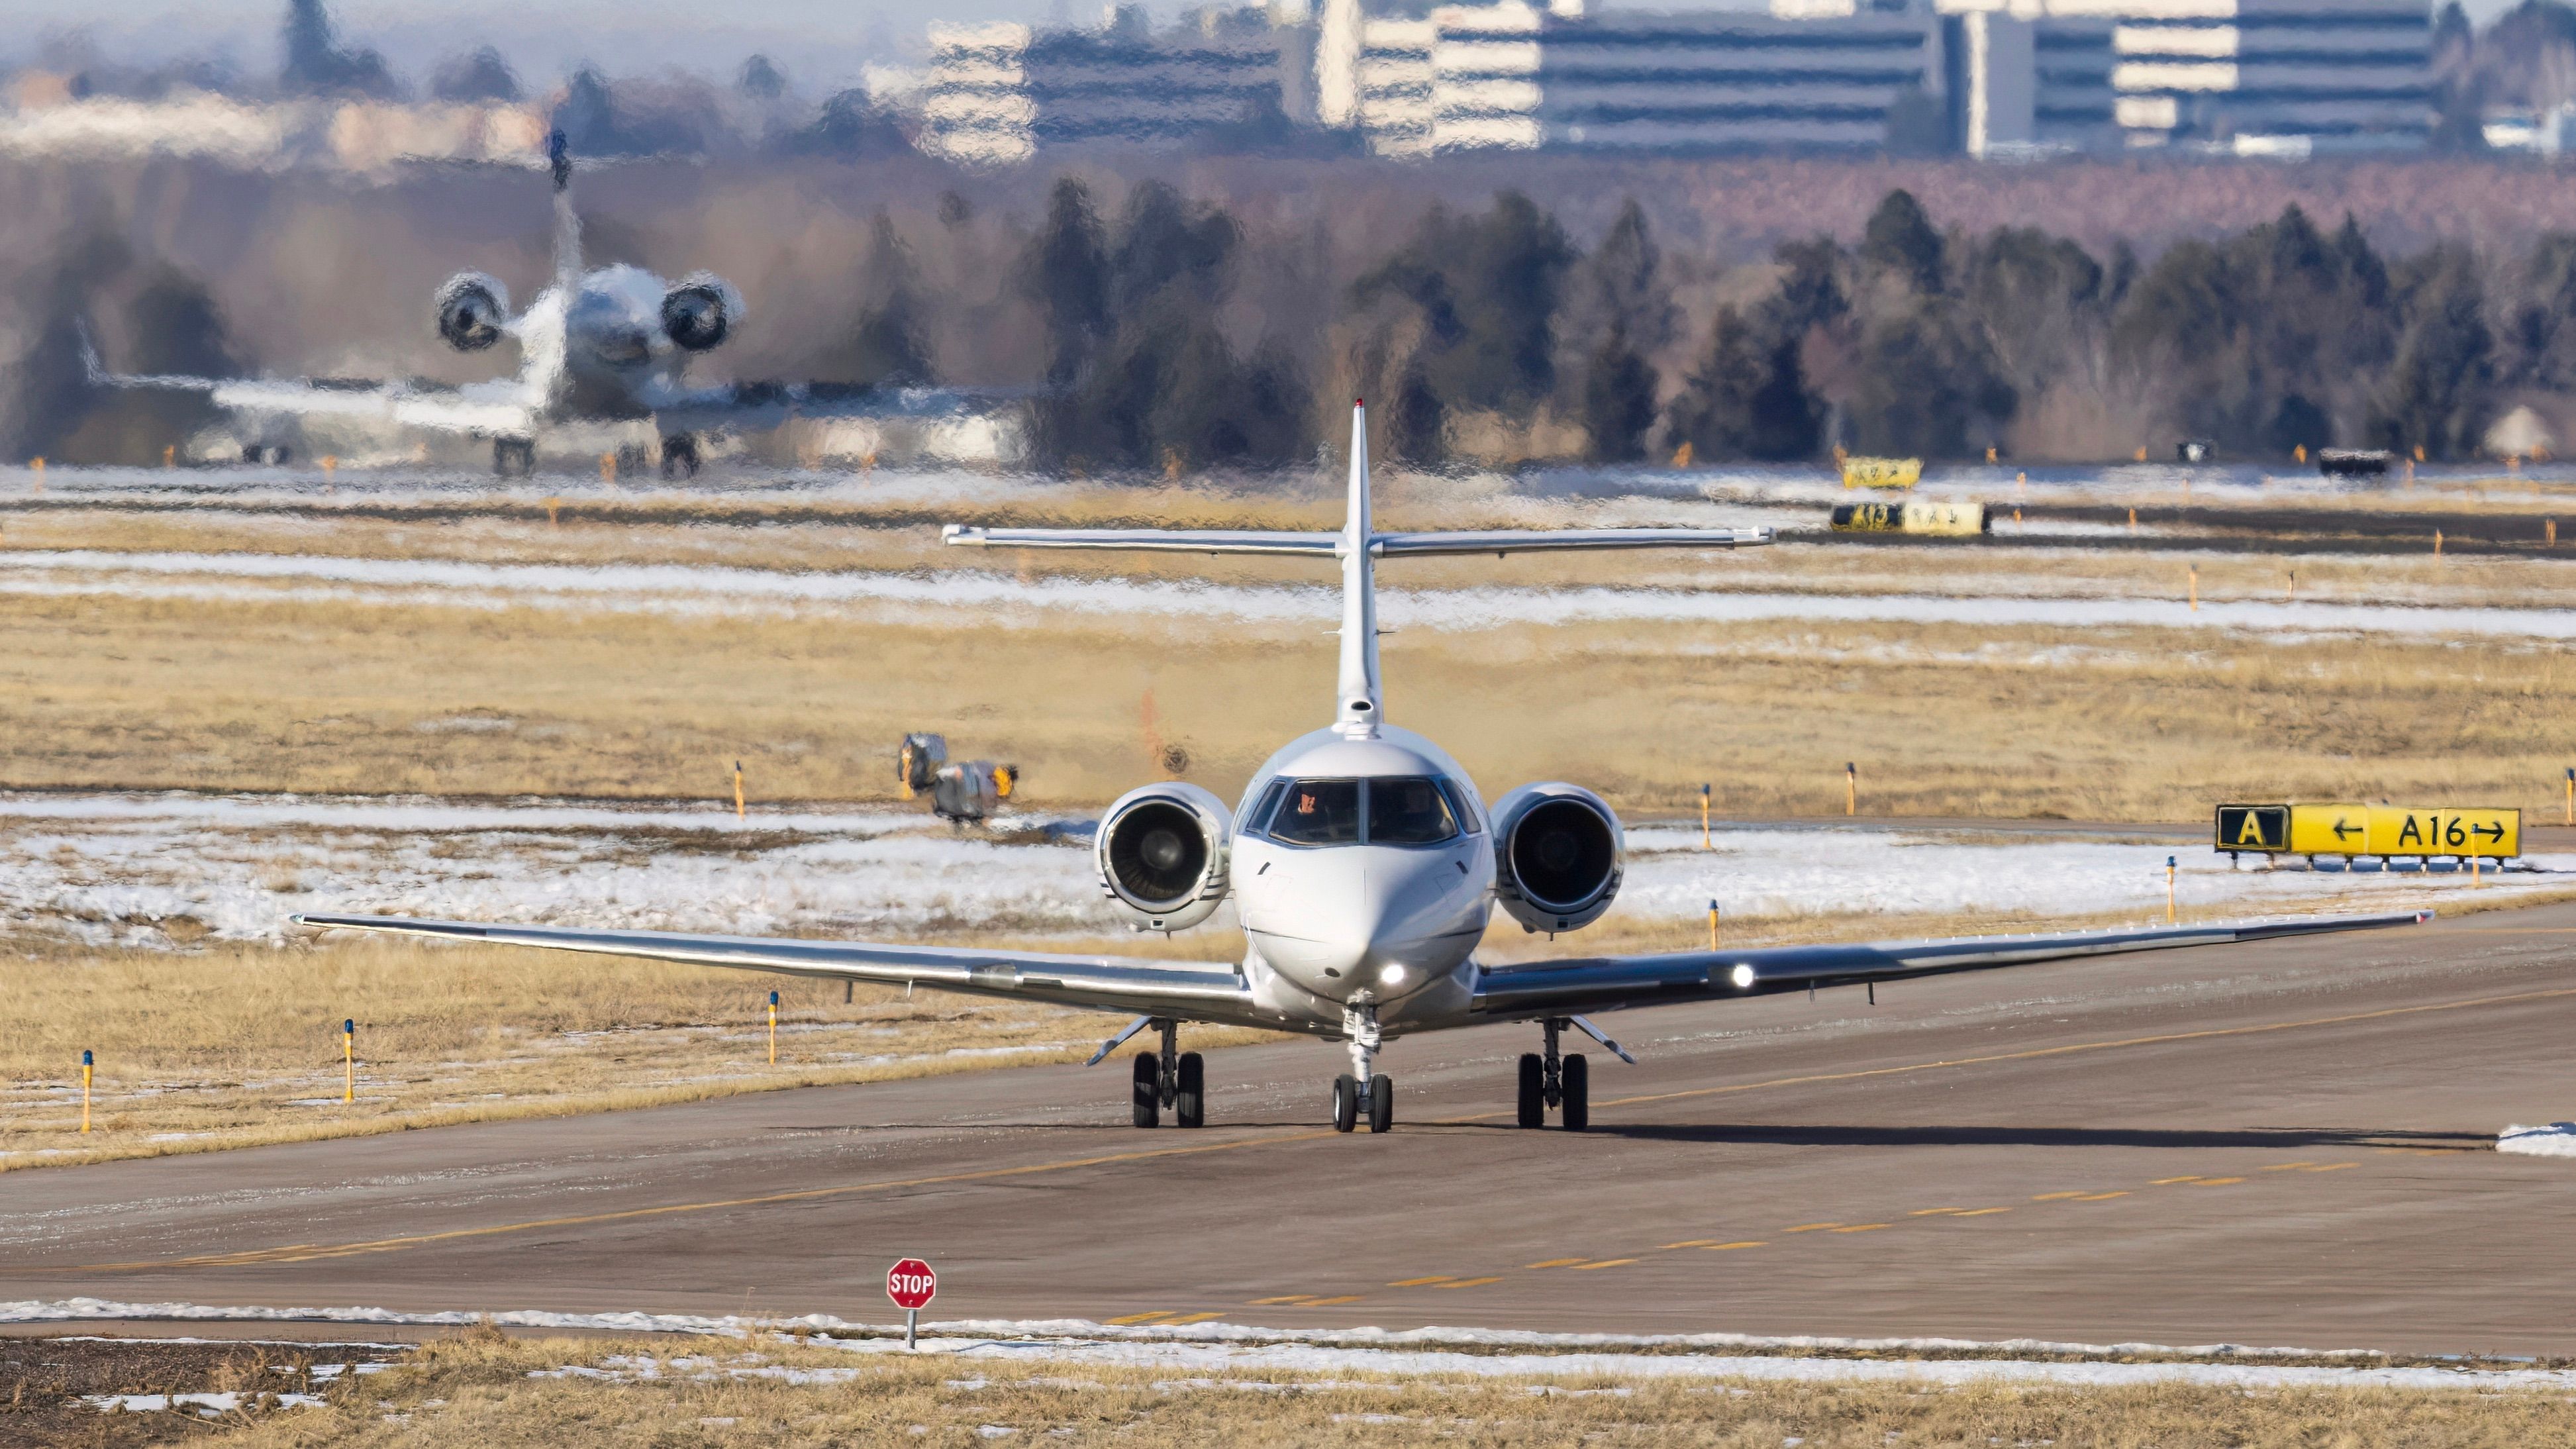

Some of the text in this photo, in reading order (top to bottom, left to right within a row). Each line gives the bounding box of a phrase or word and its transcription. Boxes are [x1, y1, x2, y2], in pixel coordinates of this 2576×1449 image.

[2238, 810, 2266, 844] A
[2398, 815, 2465, 847] A16
[890, 1273, 933, 1294] STOP
